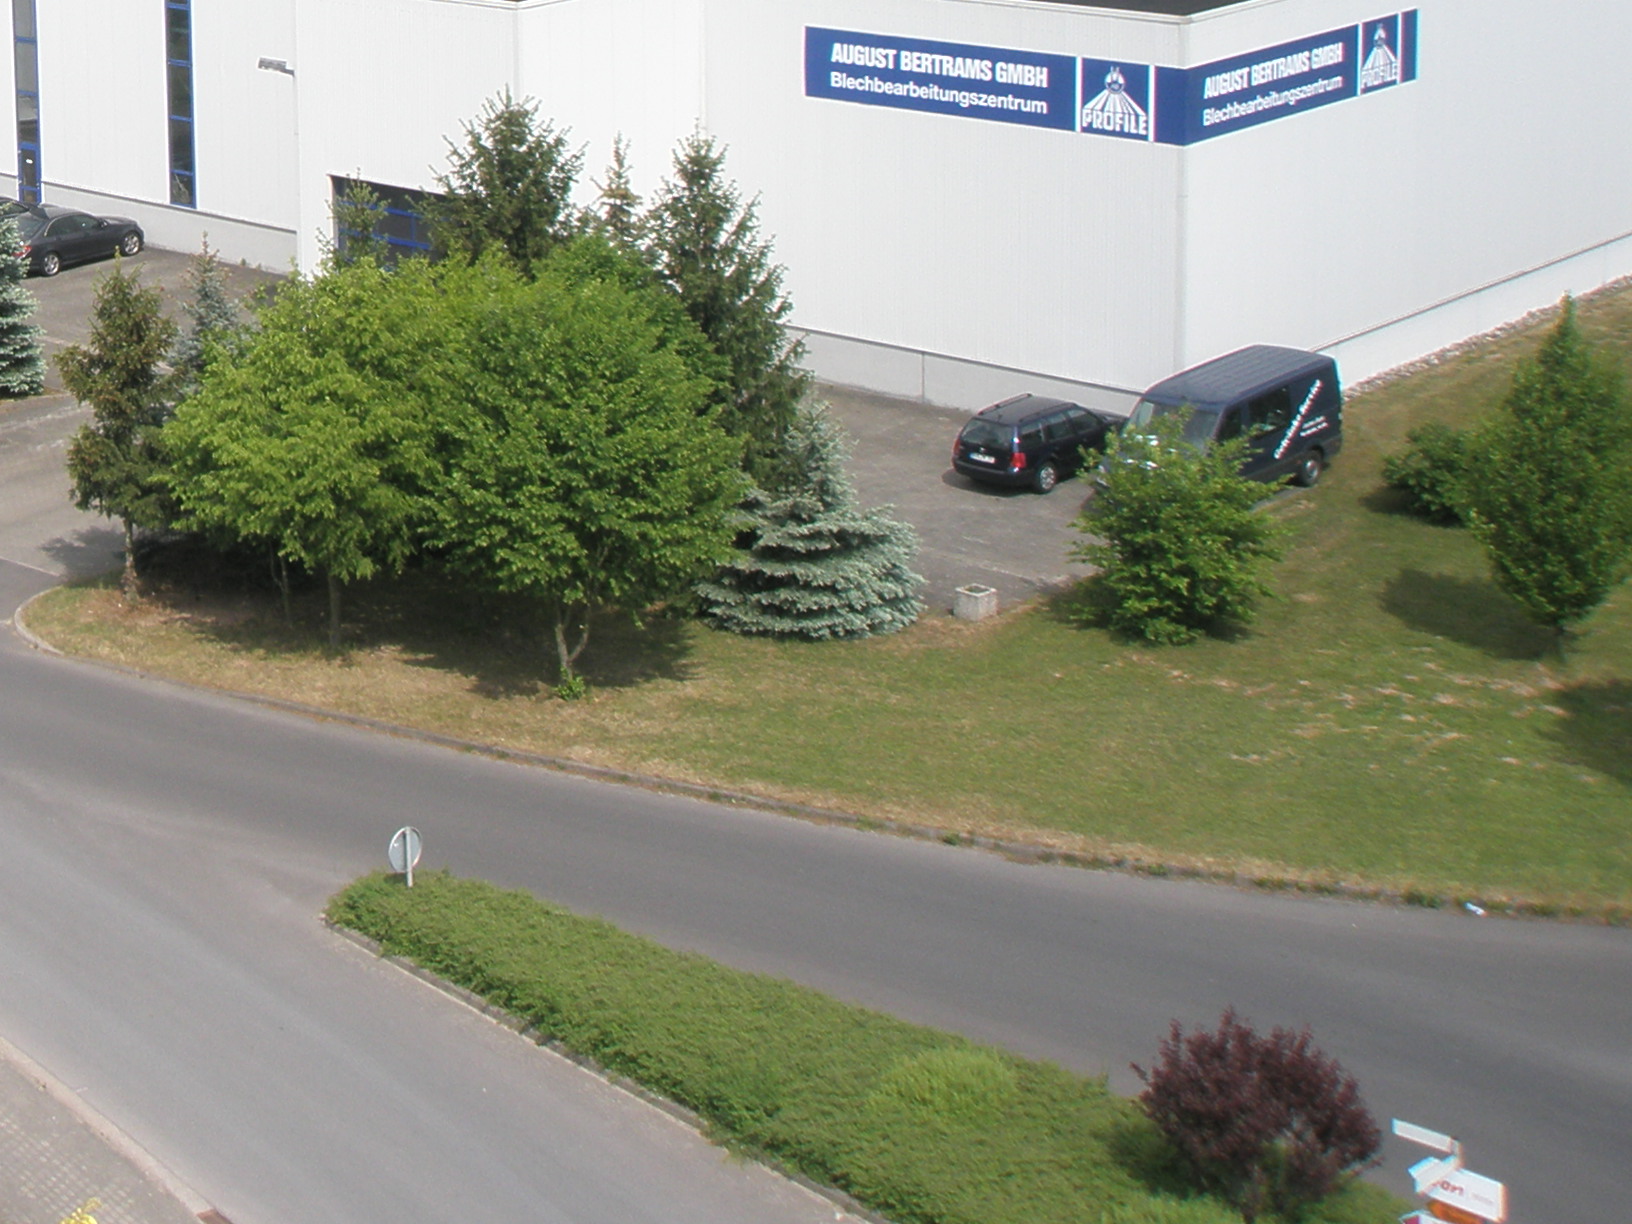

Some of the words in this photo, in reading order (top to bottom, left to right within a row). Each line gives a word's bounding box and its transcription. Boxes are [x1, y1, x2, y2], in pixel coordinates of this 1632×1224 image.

[831, 43, 897, 70] AUGUST
[900, 51, 992, 81] BERTRAMS
[995, 62, 1048, 88] GMBH
[1203, 67, 1250, 99] AUGUST
[1251, 51, 1310, 86] BERTRAMS
[1311, 42, 1344, 69] GMBH
[830, 71, 1048, 114] Blechbearbeitungszentrum
[1203, 76, 1343, 126] Blechbearbeitungszentrum
[1081, 109, 1147, 135] PROFILE
